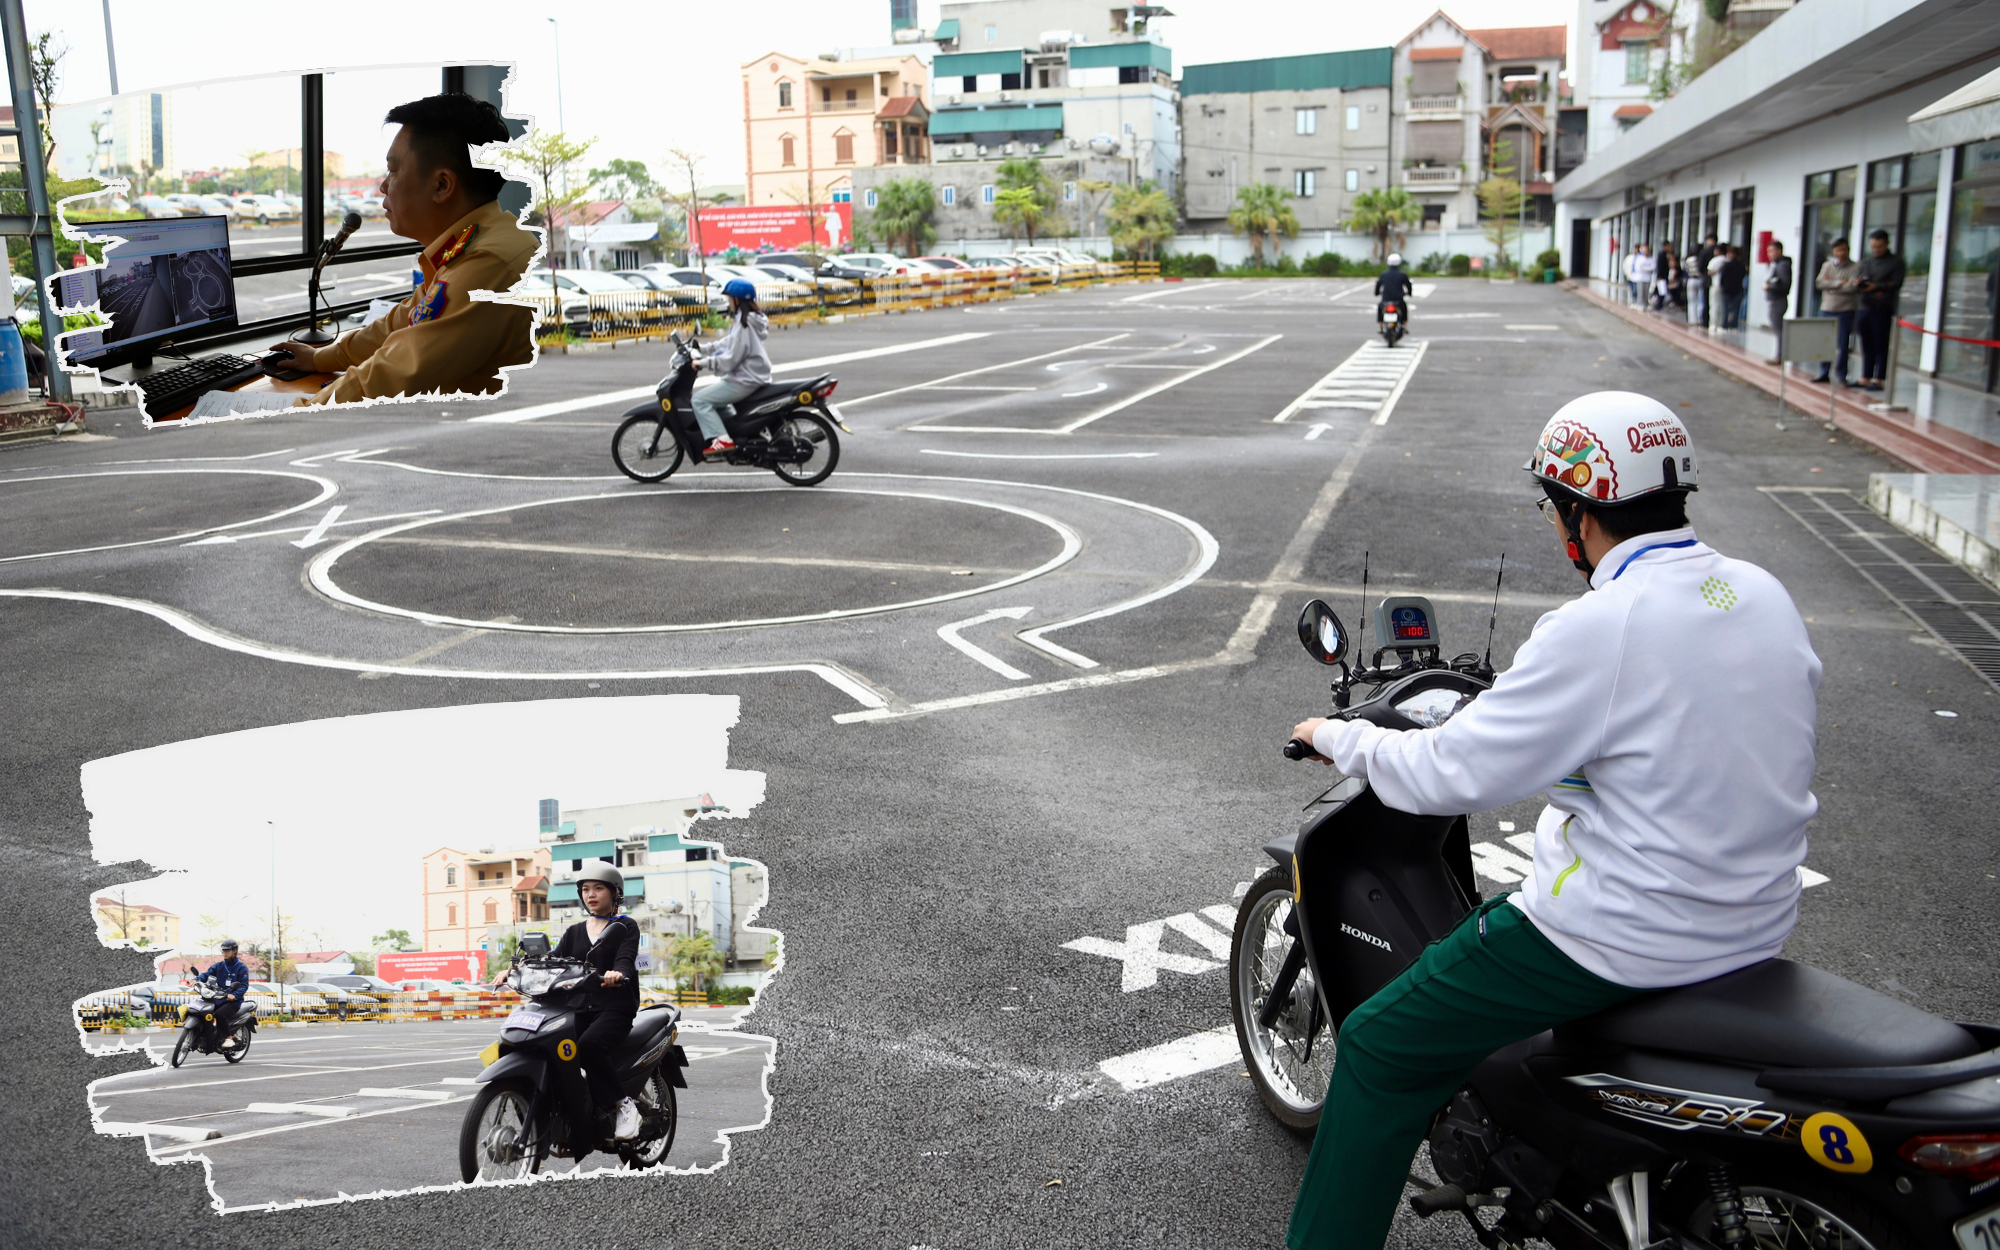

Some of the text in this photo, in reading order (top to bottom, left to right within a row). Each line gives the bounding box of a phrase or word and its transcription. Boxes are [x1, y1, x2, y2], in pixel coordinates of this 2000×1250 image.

[1408, 626, 1423, 637] 100
[1340, 922, 1393, 952] HONDA
[562, 1043, 573, 1057] 8
[1599, 1090, 1669, 1112] WAVE
[1818, 1125, 1855, 1165] 8
[1970, 1175, 2000, 1195] HONDA
